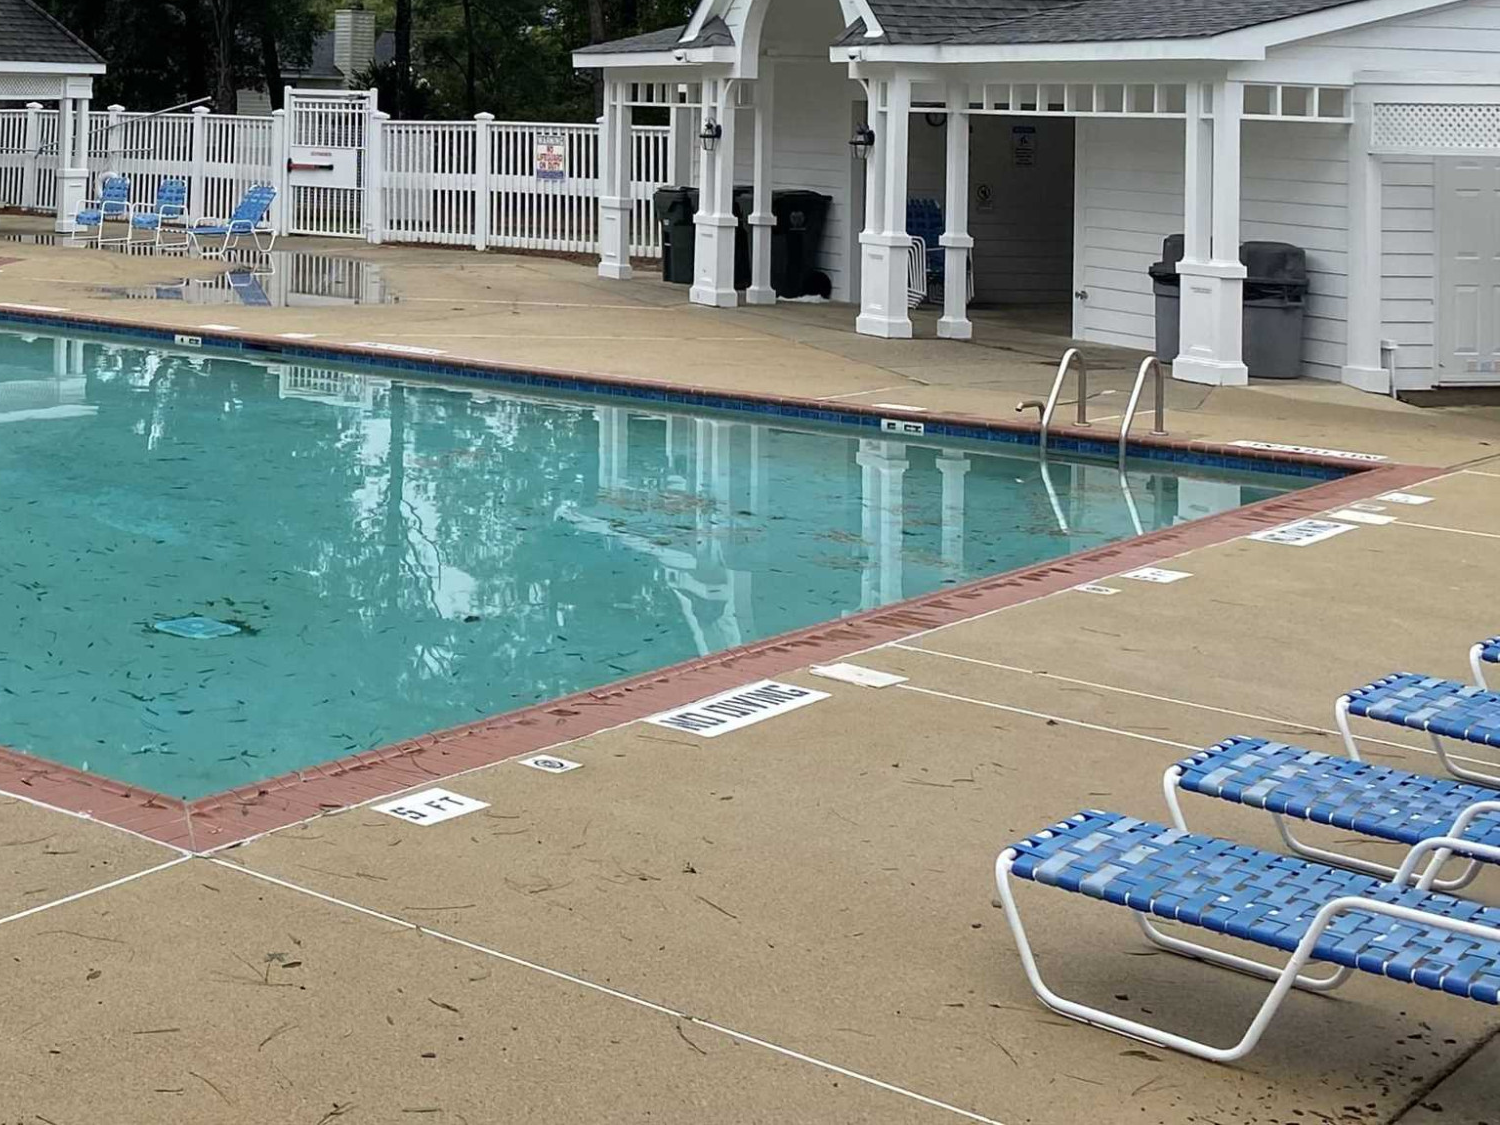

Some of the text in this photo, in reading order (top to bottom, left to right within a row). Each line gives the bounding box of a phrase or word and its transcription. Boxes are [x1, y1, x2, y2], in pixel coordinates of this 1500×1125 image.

[537, 153, 563, 162] LIFEGUARD
[659, 684, 810, 732] NO DIVING
[389, 795, 465, 820] 5 FT
